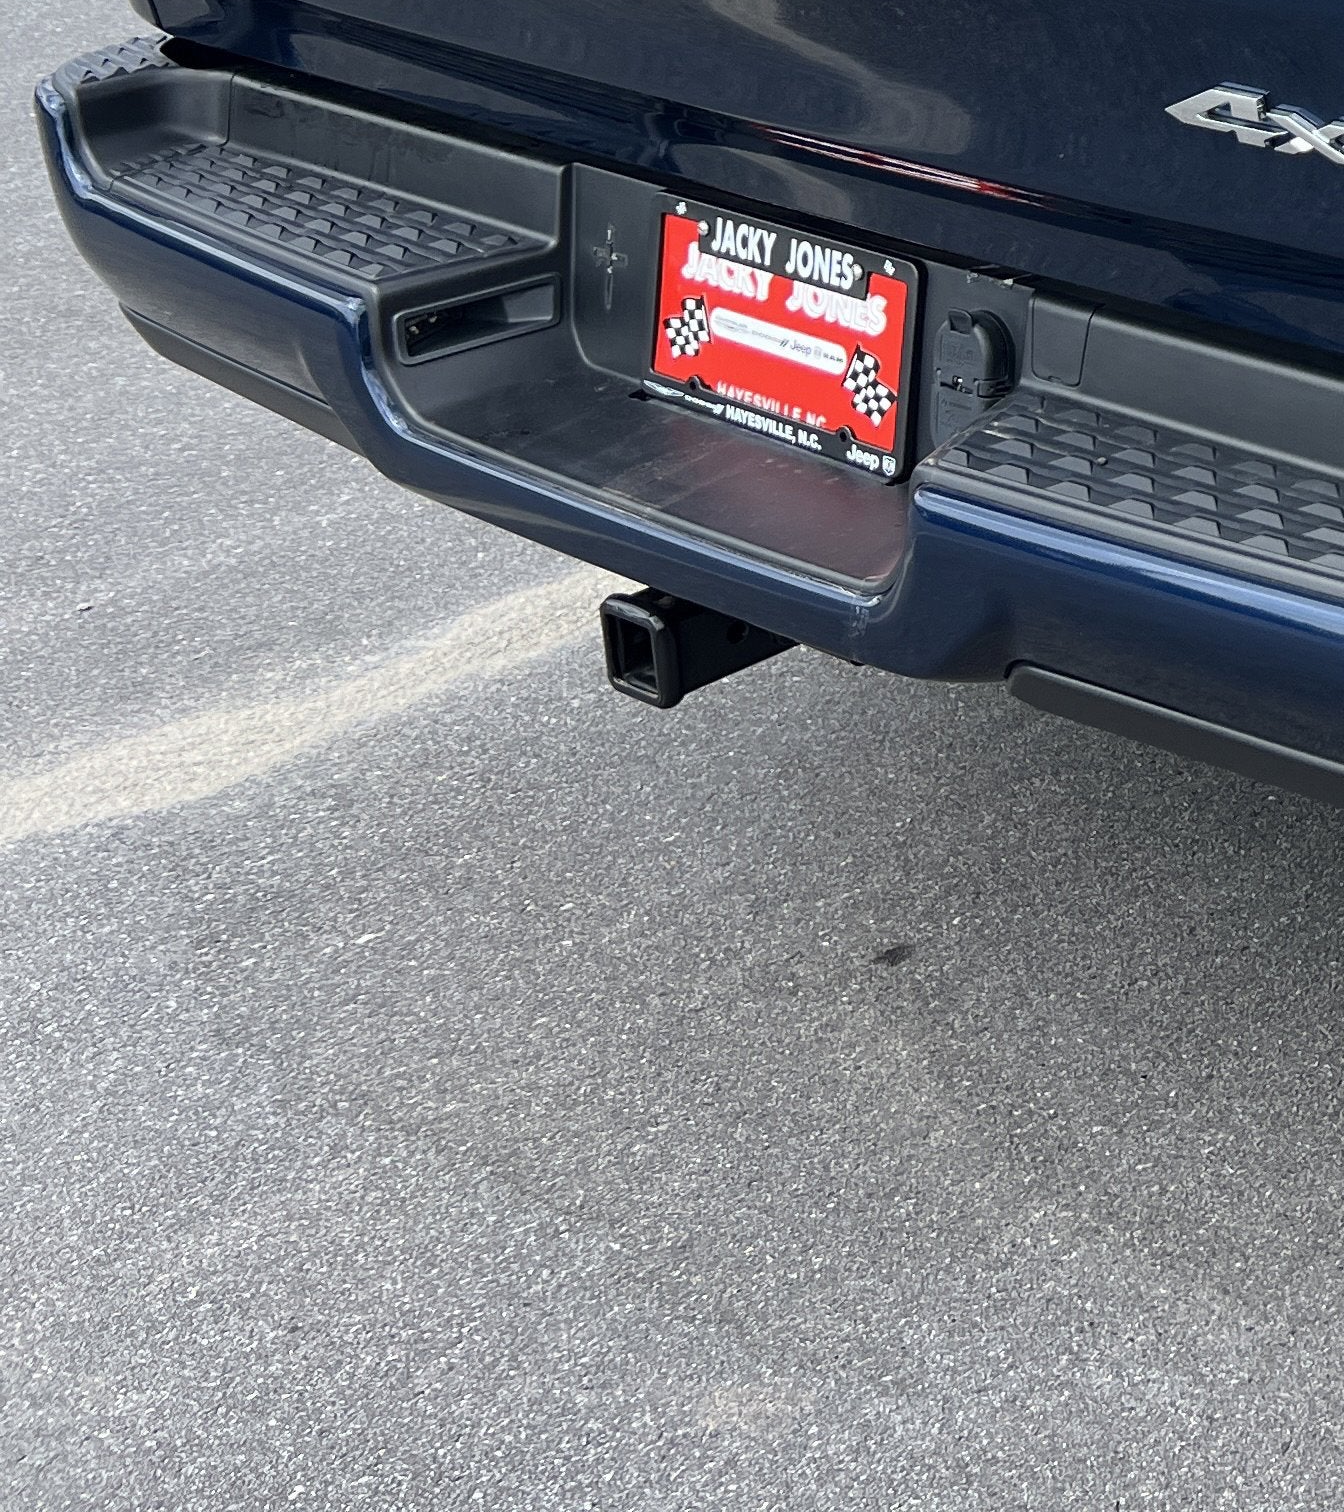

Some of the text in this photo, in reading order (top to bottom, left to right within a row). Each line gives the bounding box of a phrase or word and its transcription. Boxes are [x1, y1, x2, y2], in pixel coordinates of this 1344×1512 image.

[711, 217, 854, 290] JACKY JONES
[790, 339, 812, 357] Jeep
[846, 443, 880, 471] Jeep
